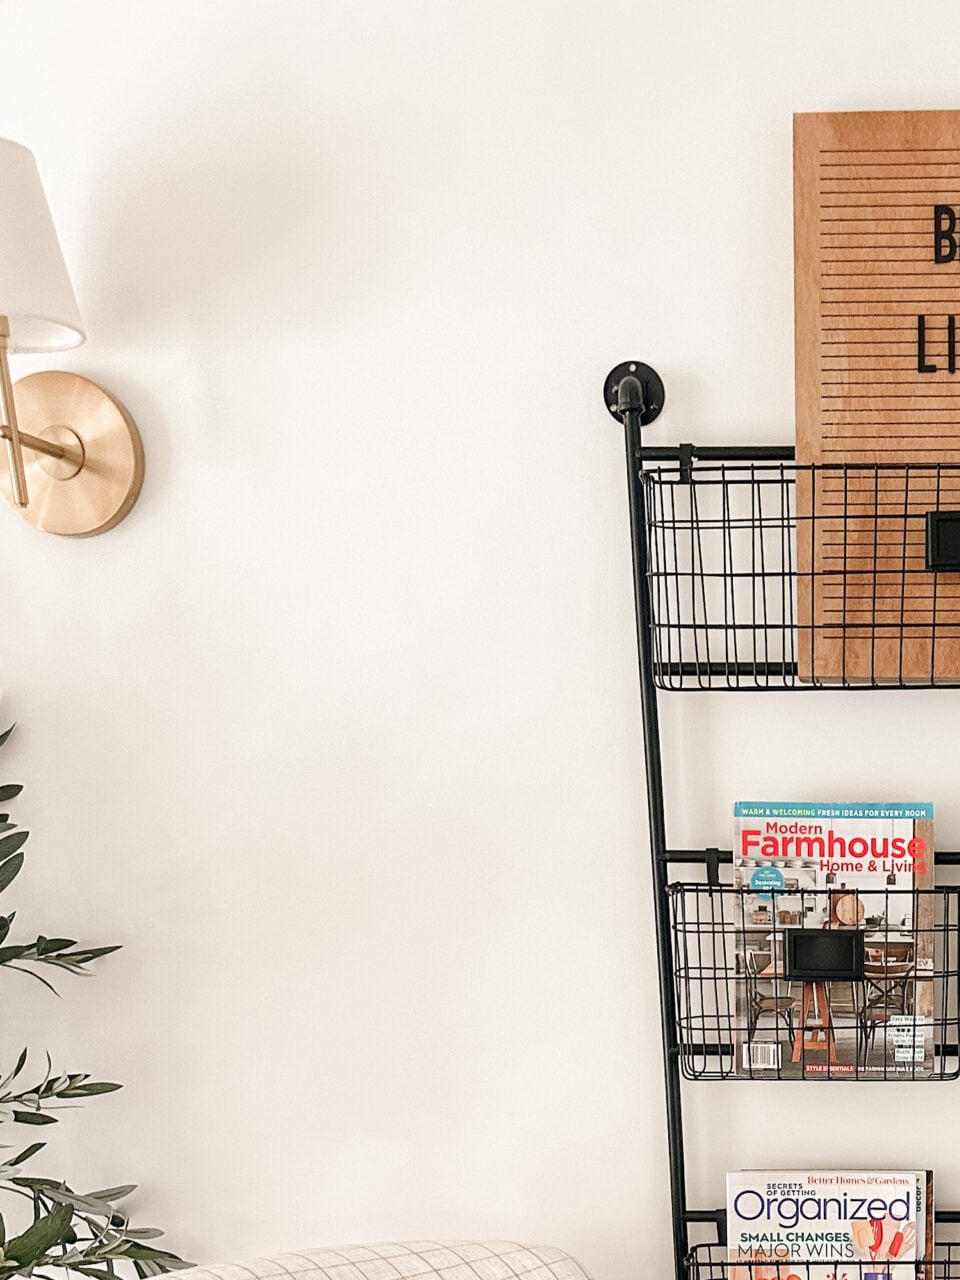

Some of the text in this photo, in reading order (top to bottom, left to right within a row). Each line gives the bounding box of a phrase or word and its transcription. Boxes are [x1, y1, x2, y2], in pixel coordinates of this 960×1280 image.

[772, 808, 816, 816] WELCOMING
[841, 809, 863, 817] IDEAS
[864, 809, 879, 817] FOR
[880, 809, 903, 817] EVERY
[905, 809, 926, 817] ROOM
[766, 821, 823, 835] Modern
[741, 829, 927, 860] Farmhouse
[820, 859, 927, 876] Home & Living
[807, 1176, 833, 1185] Better
[836, 1176, 865, 1185] Homes
[874, 1176, 910, 1185] Gardens
[733, 1191, 910, 1229] Organized
[740, 1232, 784, 1242] SMALL
[738, 1243, 854, 1258] MAJOR WINS
